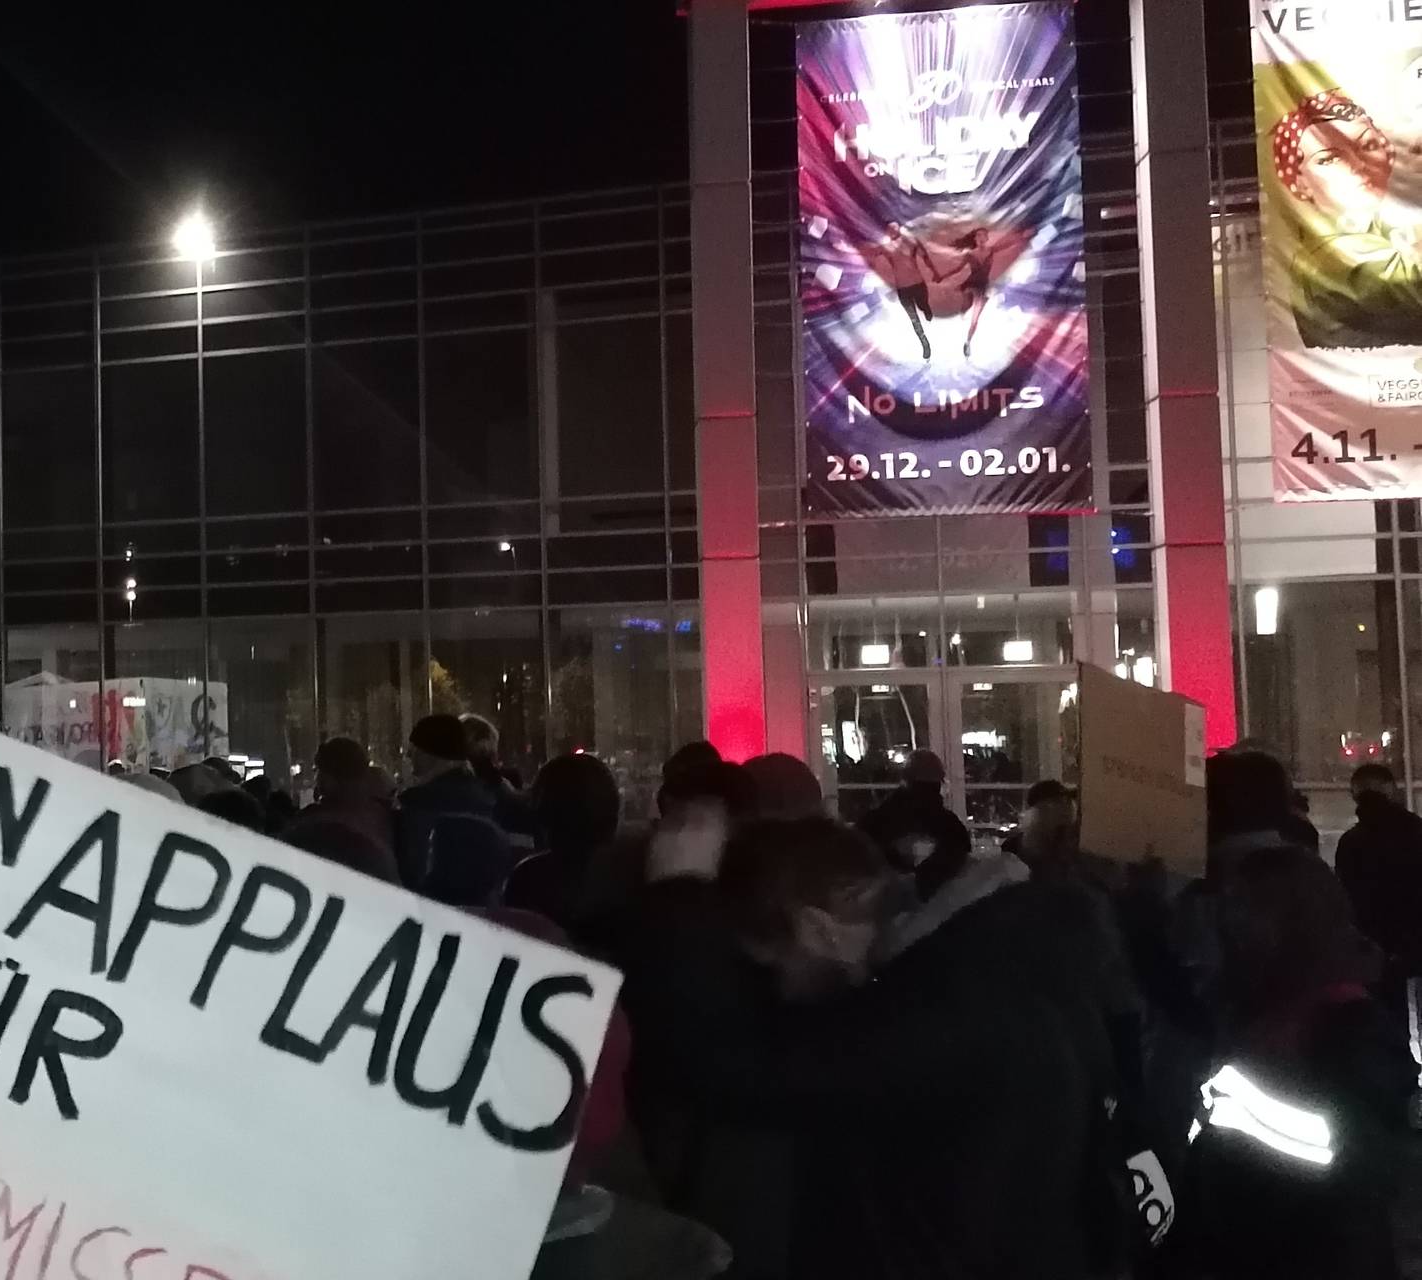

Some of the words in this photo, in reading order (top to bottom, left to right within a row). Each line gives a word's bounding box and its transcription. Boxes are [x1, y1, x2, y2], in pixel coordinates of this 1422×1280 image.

[1021, 77, 1055, 88] YEARS
[913, 386, 1045, 419] LIMITS
[826, 451, 931, 481] 29.12.
[938, 460, 952, 469] -
[959, 446, 1072, 477] 02.01.
[1291, 428, 1397, 465] 4.11.
[4, 808, 596, 1153] APPLAUS
